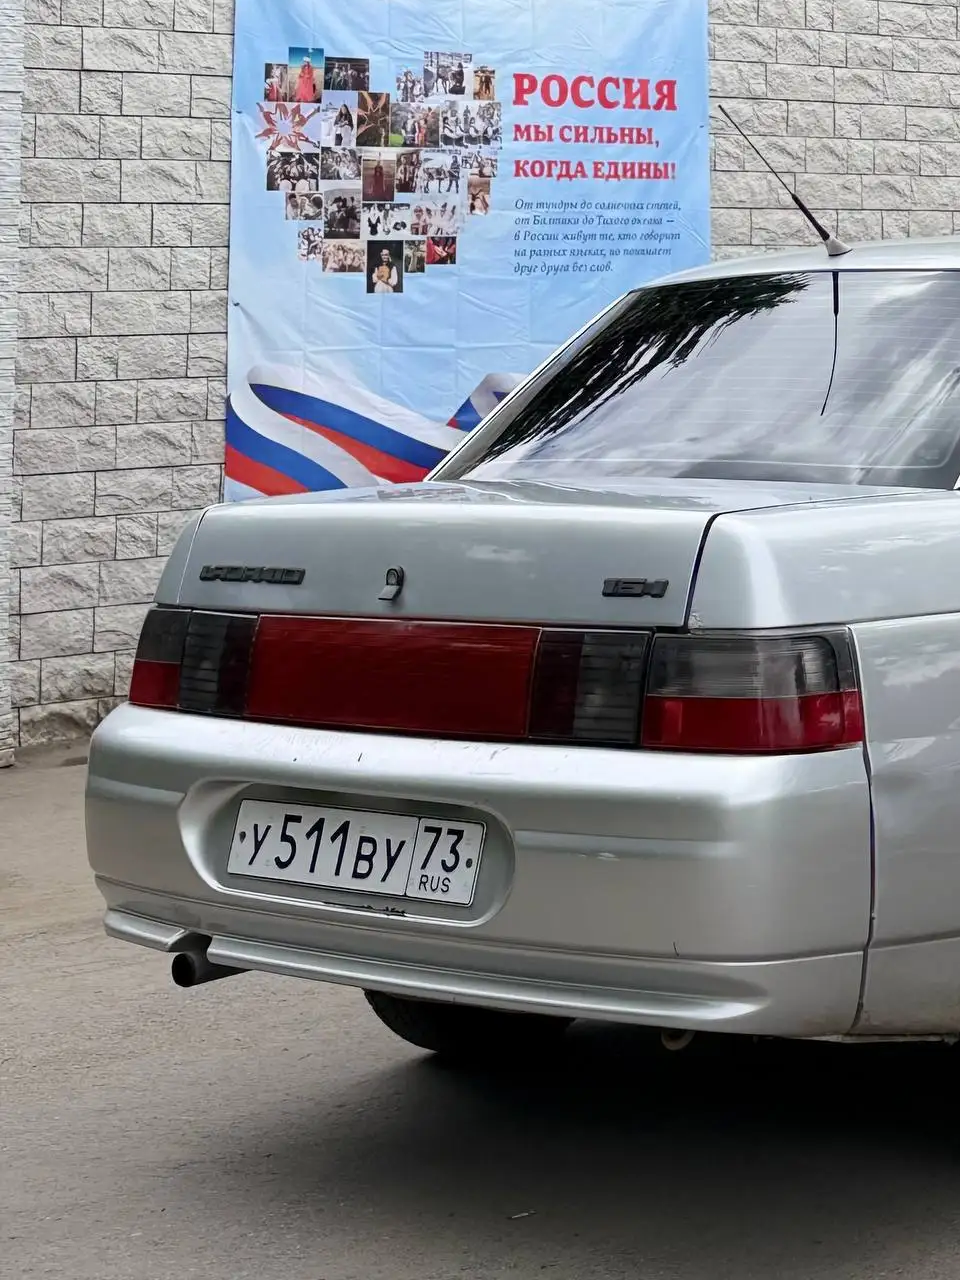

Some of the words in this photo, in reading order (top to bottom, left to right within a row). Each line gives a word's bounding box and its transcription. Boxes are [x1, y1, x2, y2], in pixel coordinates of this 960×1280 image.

[512, 73, 677, 111] РОССИЯ
[513, 124, 554, 142] МЫ
[559, 125, 659, 147] СИЛЬНЫ,
[513, 159, 588, 181] КОГДА
[592, 161, 676, 181] ЕДИНЫ!
[515, 199, 533, 210] От
[535, 200, 578, 213] тундры
[580, 200, 593, 210] до
[514, 216, 530, 225] от
[533, 214, 579, 225] Балтики
[582, 215, 594, 225] до
[596, 215, 630, 226] Тихого
[513, 230, 521, 241] в
[523, 230, 559, 241] России
[561, 230, 597, 244] живут
[617, 233, 637, 241] кто
[639, 229, 681, 244] говорит
[513, 248, 527, 257] на
[529, 248, 568, 260] разных
[609, 248, 621, 257] но
[513, 261, 539, 276] друг
[540, 261, 570, 276] друга
[572, 261, 588, 273] без
[420, 826, 465, 873] 73
[418, 874, 451, 893] RUS
